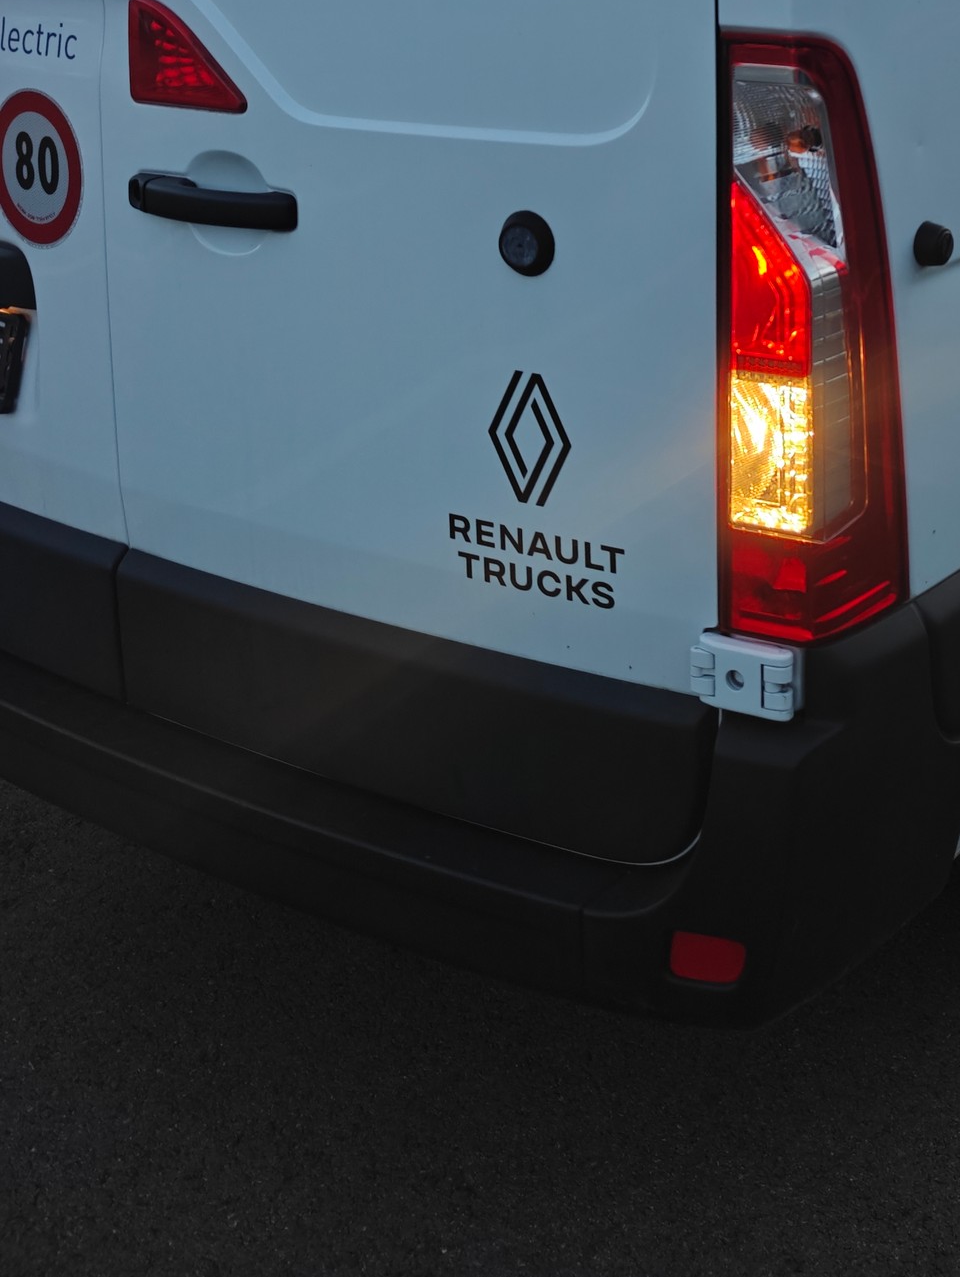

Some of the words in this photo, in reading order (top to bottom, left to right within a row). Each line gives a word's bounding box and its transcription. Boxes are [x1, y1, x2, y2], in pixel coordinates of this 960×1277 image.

[1, 16, 77, 60] lectric
[15, 131, 59, 195] 80
[449, 513, 625, 574] RENAULT
[458, 551, 615, 609] TRUCKS
